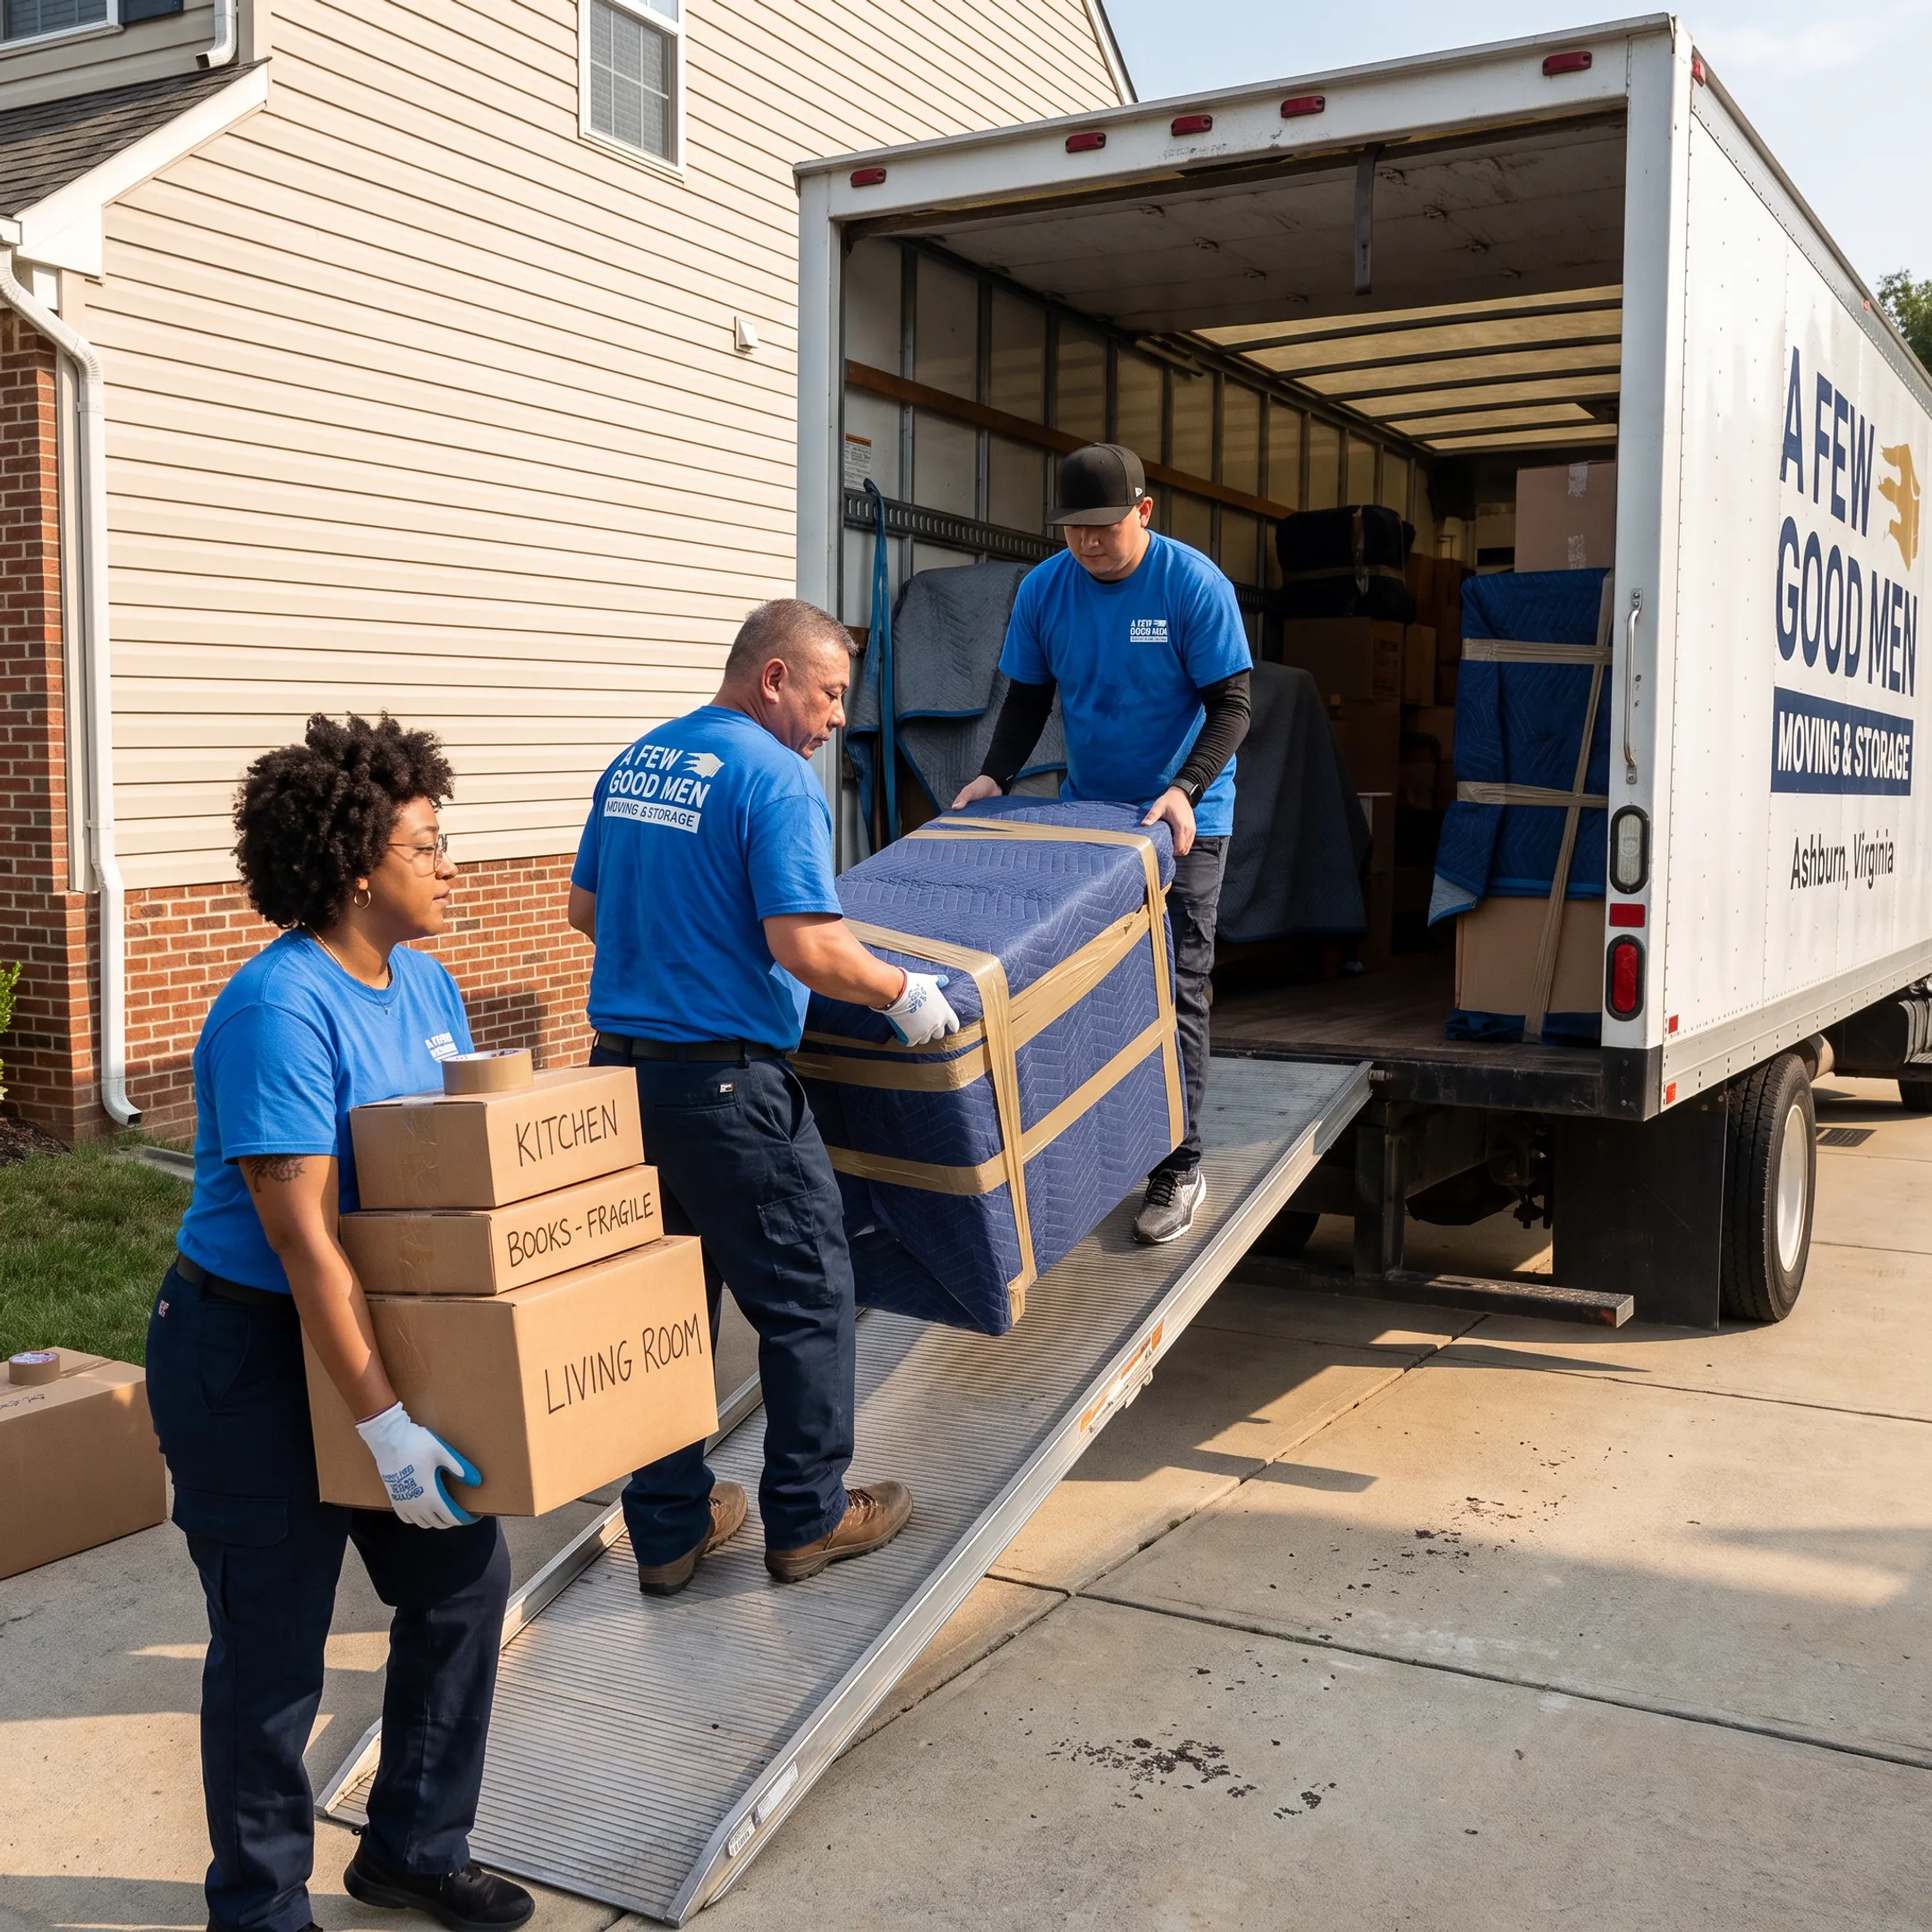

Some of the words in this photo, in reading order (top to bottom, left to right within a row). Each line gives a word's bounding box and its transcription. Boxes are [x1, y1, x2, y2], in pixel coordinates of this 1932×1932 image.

[1779, 345, 1804, 495] A
[1813, 371, 1875, 538] FEW
[1775, 515, 1863, 678] GOOD
[1868, 569, 1918, 698] MEN
[618, 746, 636, 767] A
[634, 744, 683, 771] FEW
[1777, 711, 1841, 776] MOVING
[1842, 723, 1852, 776] &
[1854, 725, 1911, 780] STORAGE
[606, 801, 638, 816] MOVING
[647, 809, 695, 828] STORAGE
[609, 769, 660, 799] GOOD
[659, 776, 711, 809] MEN
[1790, 833, 1850, 890] Ashburn,
[1853, 828, 1894, 889] Virginia
[515, 1099, 618, 1167] KITCHEN
[545, 1340, 632, 1415] LIVING
[642, 1312, 702, 1373] ROOM
